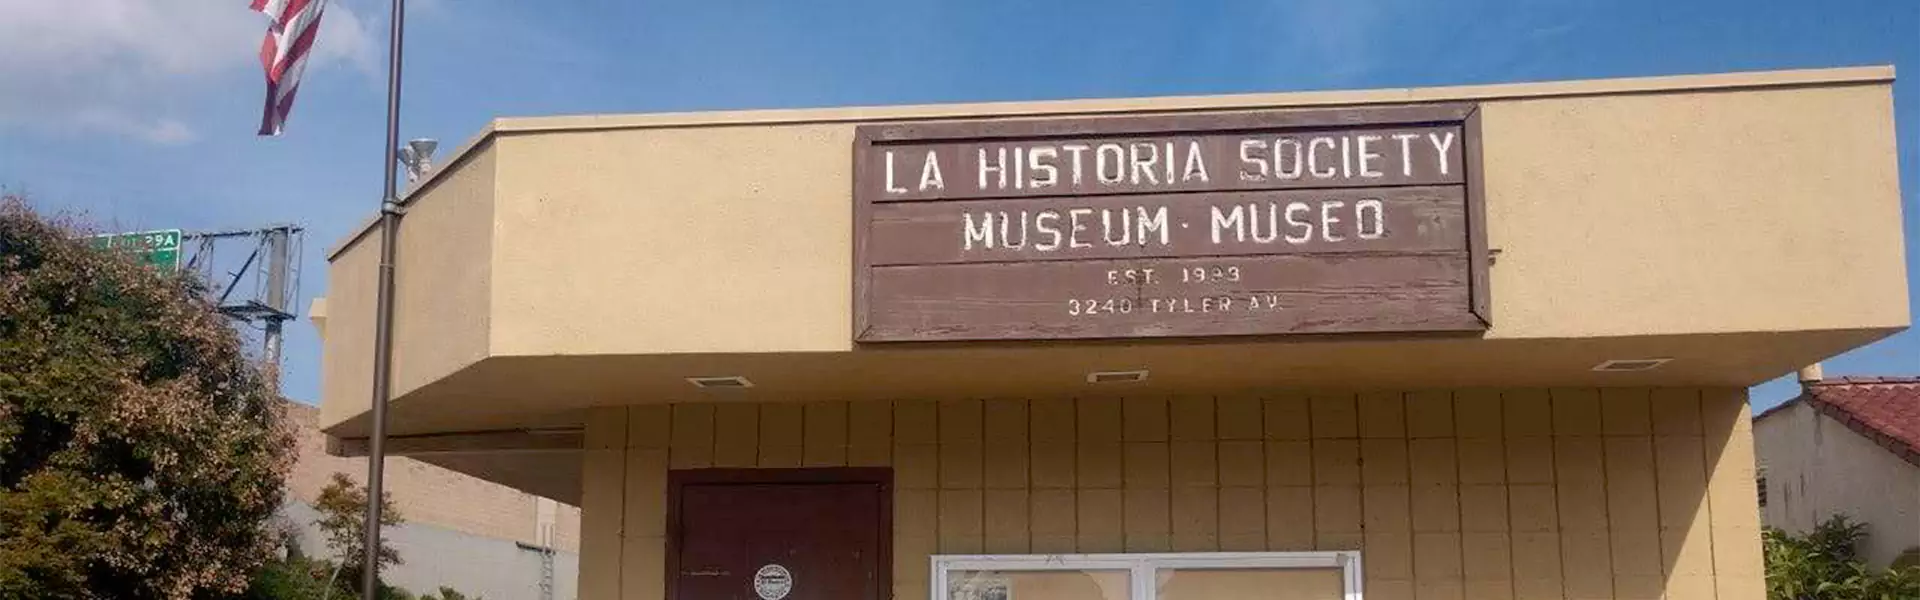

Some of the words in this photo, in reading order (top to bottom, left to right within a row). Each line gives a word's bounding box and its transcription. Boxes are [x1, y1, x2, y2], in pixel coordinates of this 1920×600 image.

[886, 150, 944, 193] LA
[979, 141, 1209, 189] HISTORIA
[1239, 132, 1454, 181] SOCIETY
[963, 206, 1168, 250] MUSEUM
[1211, 199, 1383, 244] MUSEO
[1108, 268, 1159, 285] EST.
[1068, 298, 1132, 316] 3240
[1151, 296, 1232, 313] TYLER
